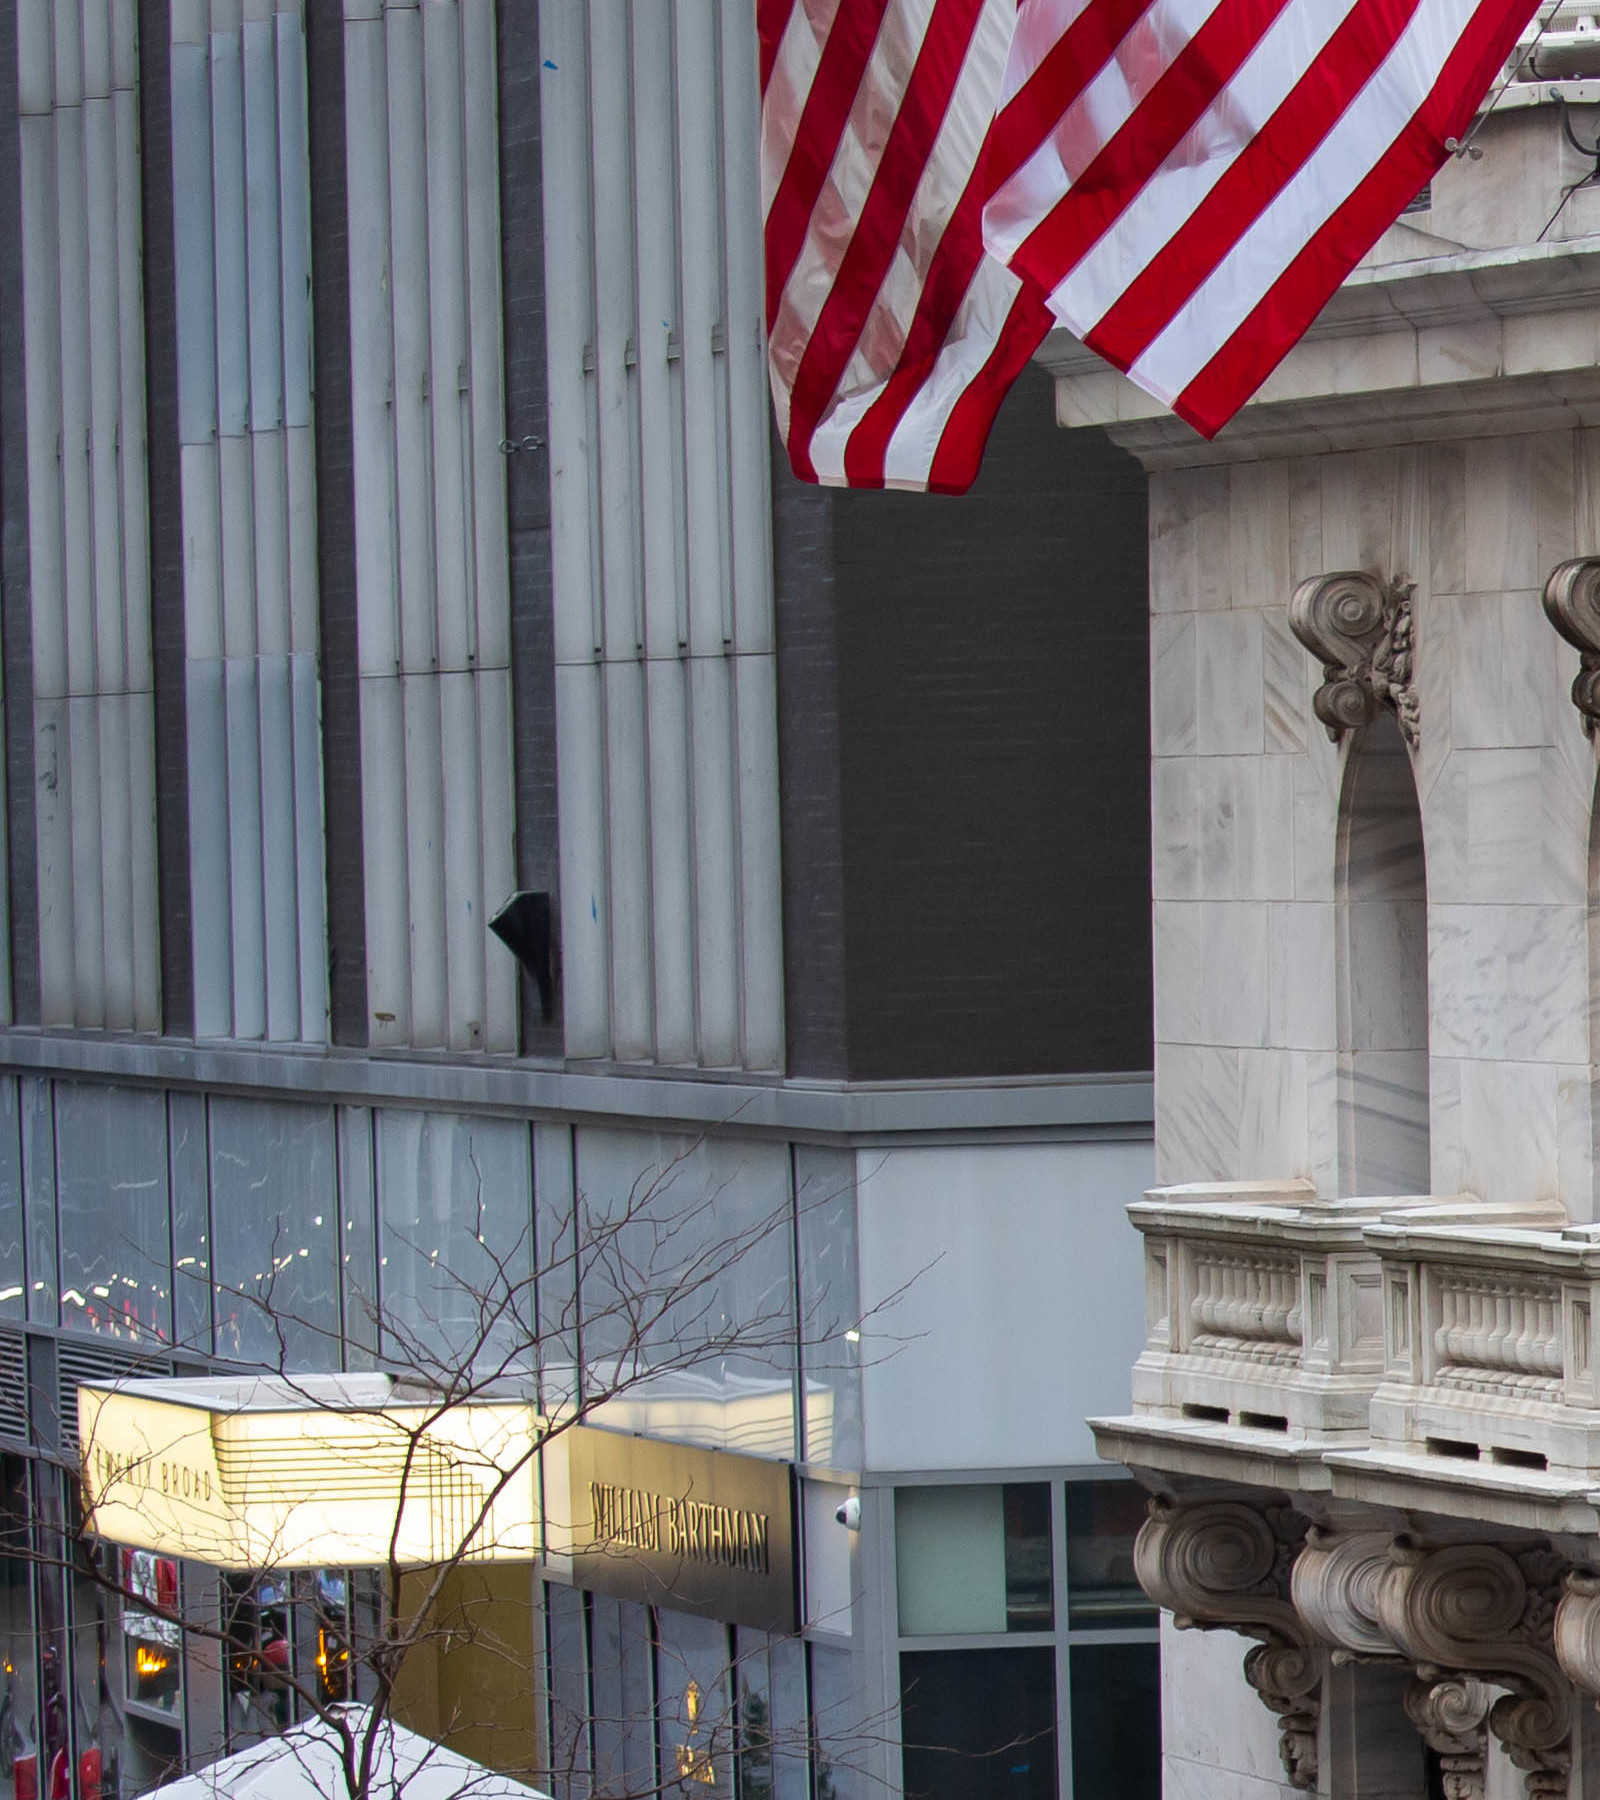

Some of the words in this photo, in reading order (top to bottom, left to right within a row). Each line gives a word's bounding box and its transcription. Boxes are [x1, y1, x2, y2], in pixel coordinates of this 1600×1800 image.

[161, 1462, 211, 1502] BROAD
[588, 1481, 660, 1553] WILLIAM
[665, 1496, 769, 1575] BARTHMAN
